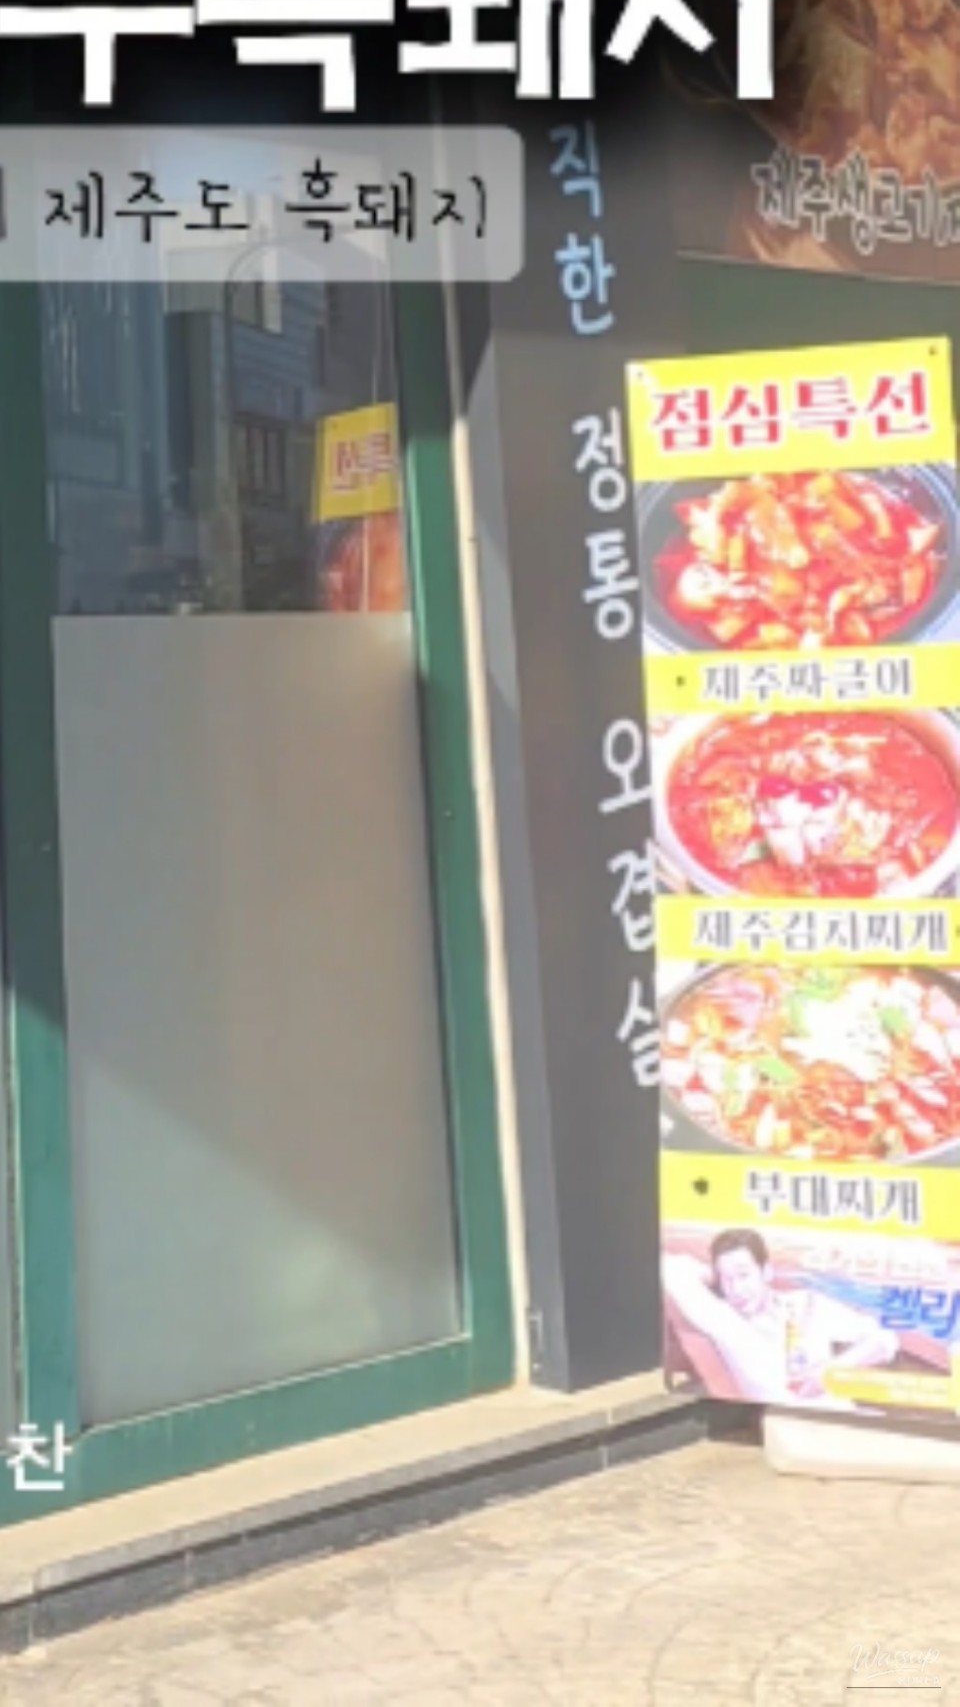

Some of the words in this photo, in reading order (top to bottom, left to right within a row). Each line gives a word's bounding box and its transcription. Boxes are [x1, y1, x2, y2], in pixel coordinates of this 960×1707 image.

[651, 371, 931, 452] 점심특선
[571, 406, 639, 640] 정통
[704, 658, 910, 701] 제주짜글이
[694, 910, 949, 952] 제주김치찌개
[746, 1171, 920, 1223] 부대찌개
[880, 1284, 960, 1339] 켈리
